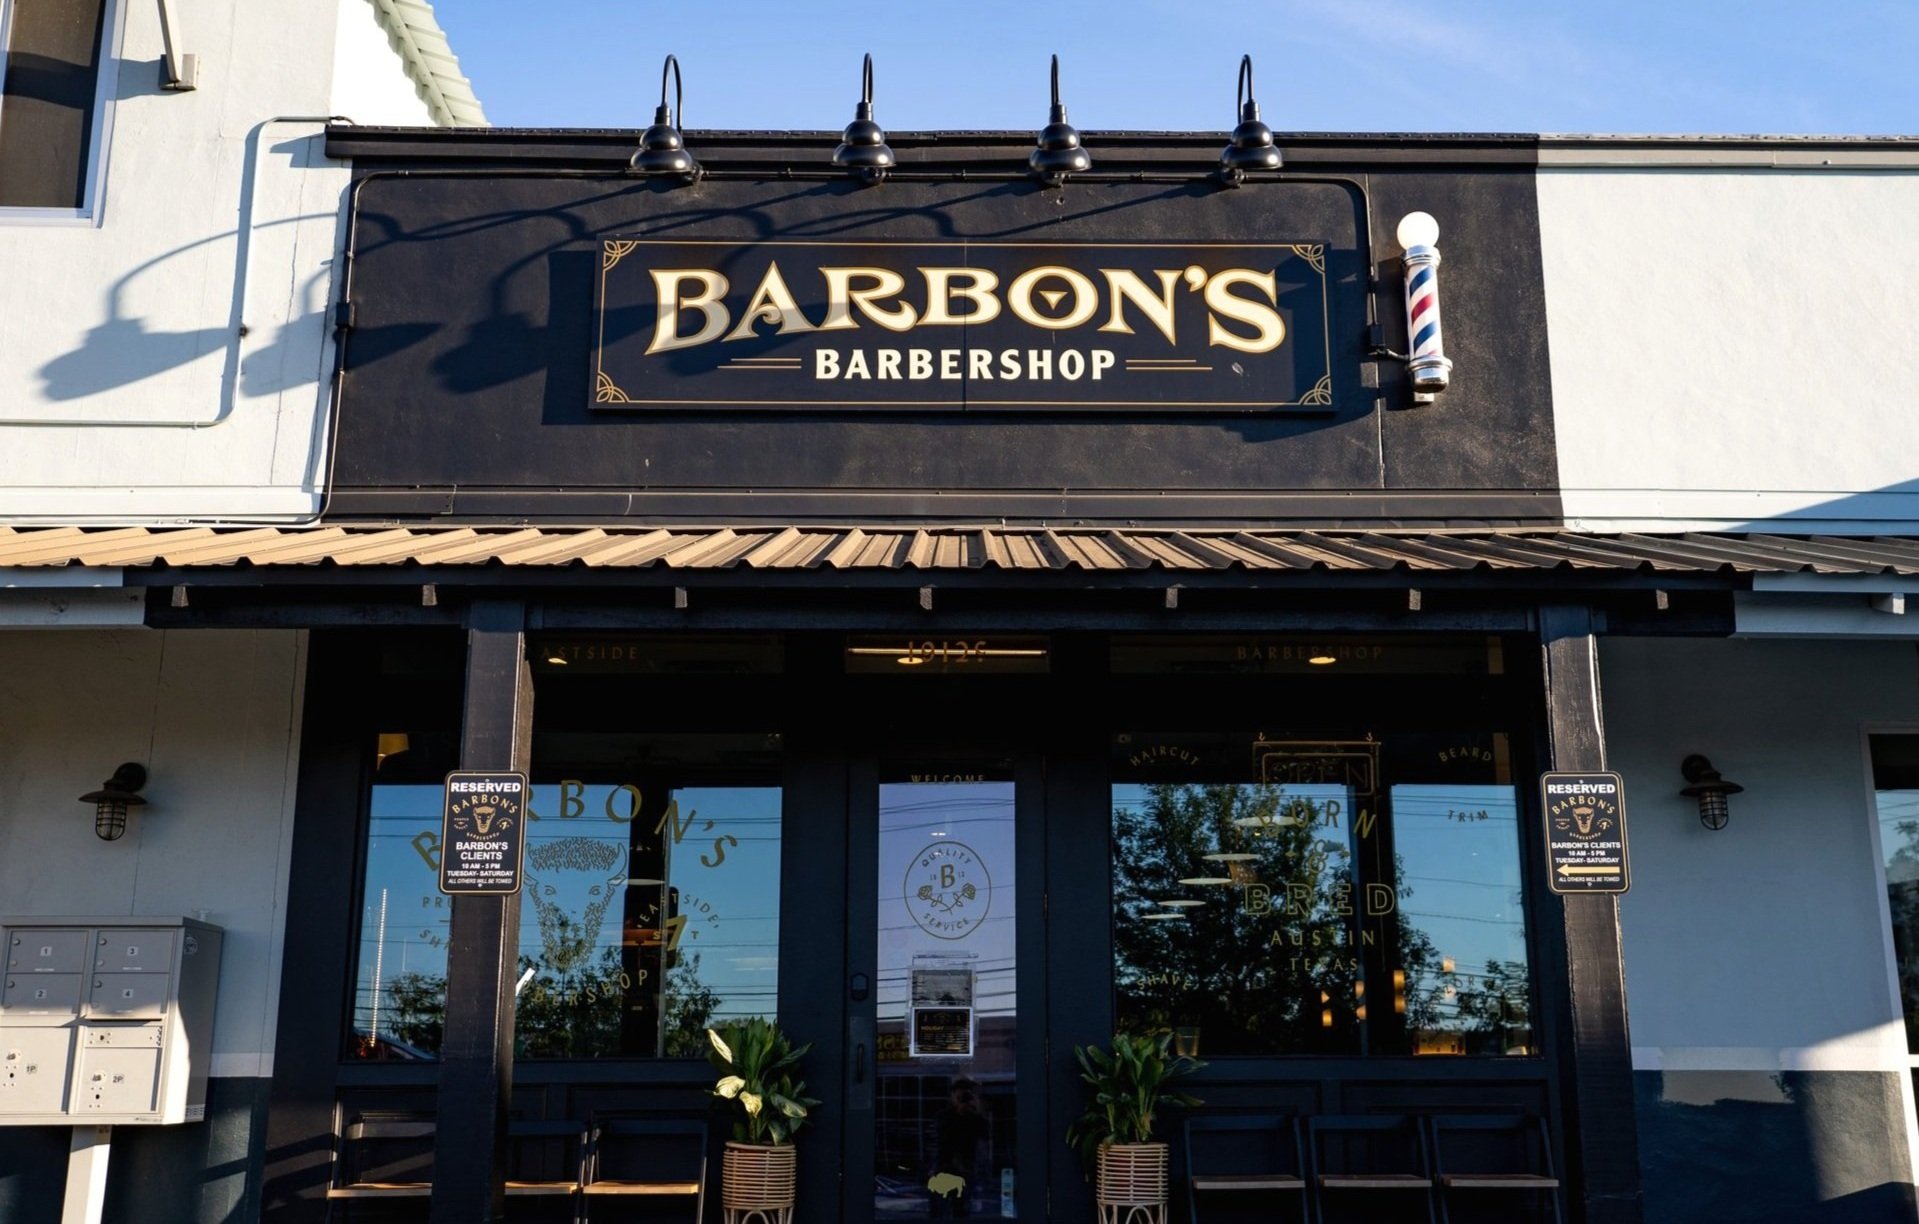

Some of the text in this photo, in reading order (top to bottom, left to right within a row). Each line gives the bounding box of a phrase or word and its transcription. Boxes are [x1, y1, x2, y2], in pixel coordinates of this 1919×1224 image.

[644, 260, 1286, 355] BARBON'S
[815, 348, 1117, 381] BARBERSHOP
[542, 646, 638, 660] ASTSIDE
[1237, 645, 1383, 660] BARBERSHOP
[1130, 745, 1200, 767] HAIRCUT
[1438, 746, 1492, 762] BEARD
[450, 782, 521, 793] RESERVED
[1547, 784, 1616, 794] RESERVED
[452, 794, 518, 814] BARBON'S
[1551, 795, 1615, 815] BARBON'S
[1257, 799, 1376, 839] BORN
[1448, 809, 1488, 822] TRIM
[456, 842, 508, 851] BARBON'S
[460, 851, 503, 861] CLIENTS
[922, 848, 972, 867] QUALITY
[941, 864, 955, 888] B
[1244, 883, 1395, 916] BRED
[923, 913, 969, 931] SERVICE
[665, 915, 688, 951] 7
[1270, 929, 1375, 946] AUSTIN
[1289, 957, 1358, 971] TEXAS
[112, 1075, 124, 1083] 2P
